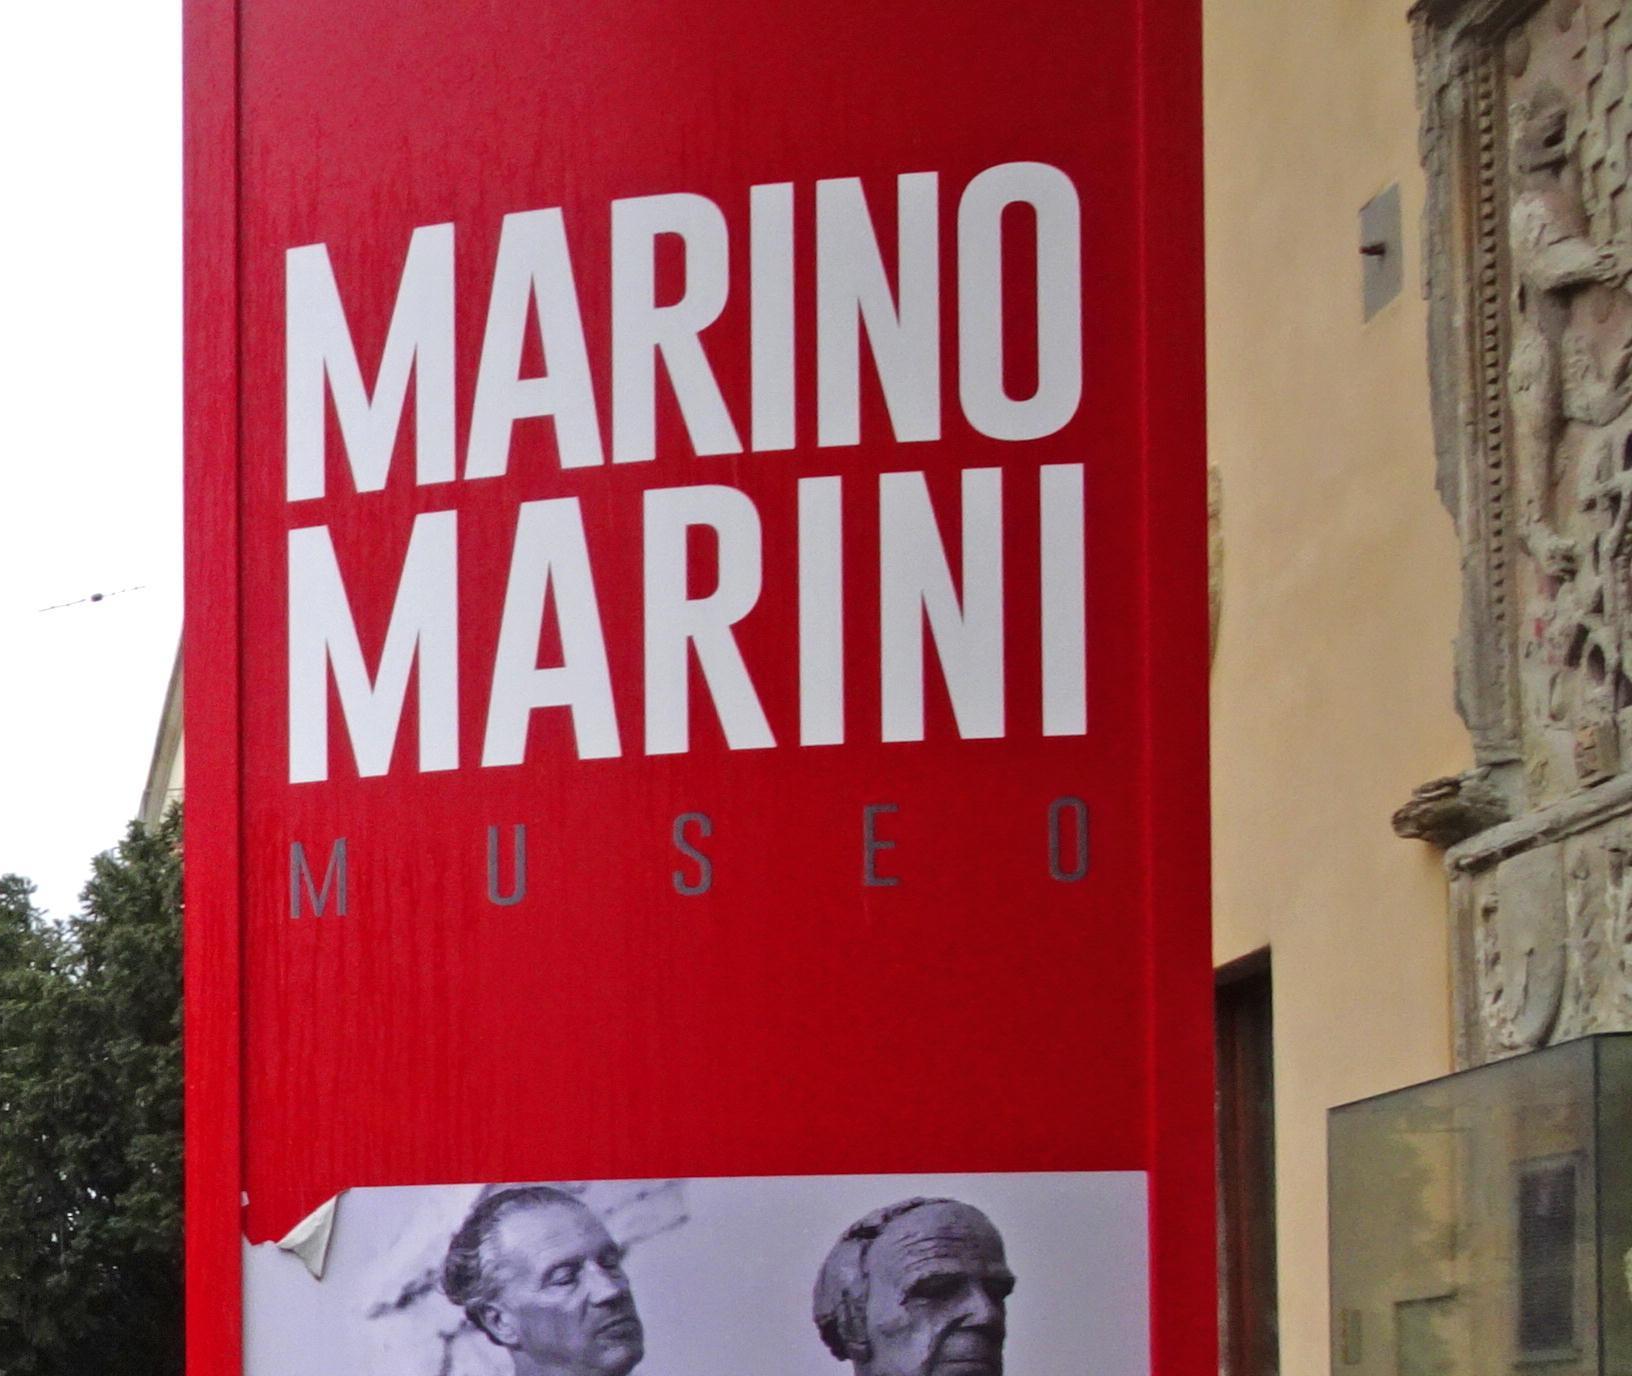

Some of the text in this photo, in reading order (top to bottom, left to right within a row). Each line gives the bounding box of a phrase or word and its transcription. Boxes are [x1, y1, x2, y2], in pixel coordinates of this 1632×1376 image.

[284, 160, 1083, 503] MARINO
[287, 462, 1088, 784] MARINI
[288, 796, 1090, 919] MUSEO
